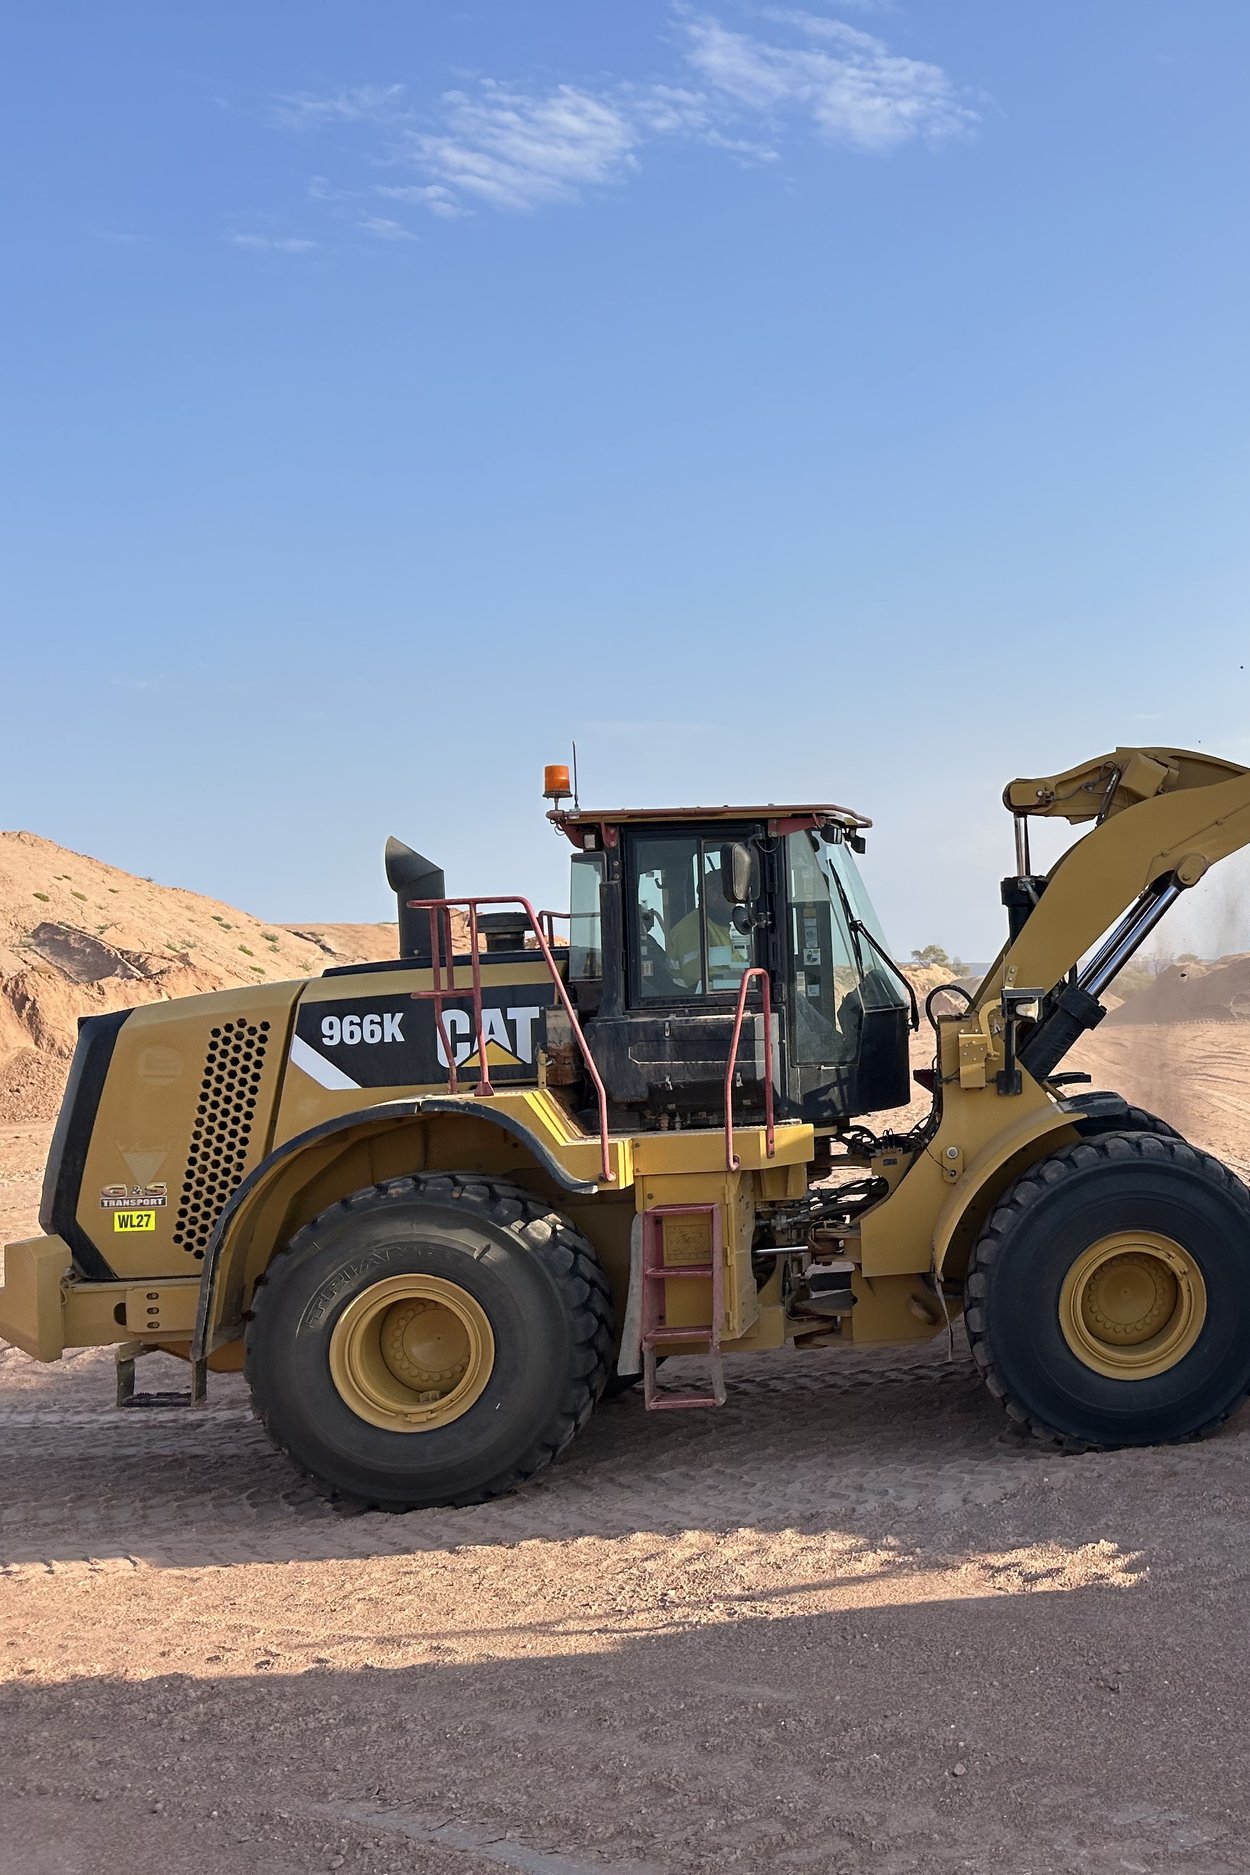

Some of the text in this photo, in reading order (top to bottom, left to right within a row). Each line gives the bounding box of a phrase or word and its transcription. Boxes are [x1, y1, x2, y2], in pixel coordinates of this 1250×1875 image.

[321, 1013, 405, 1046] 966K
[436, 1006, 540, 1068] CAT
[102, 1198, 164, 1207] TRANSPORT
[117, 1214, 152, 1228] WL27
